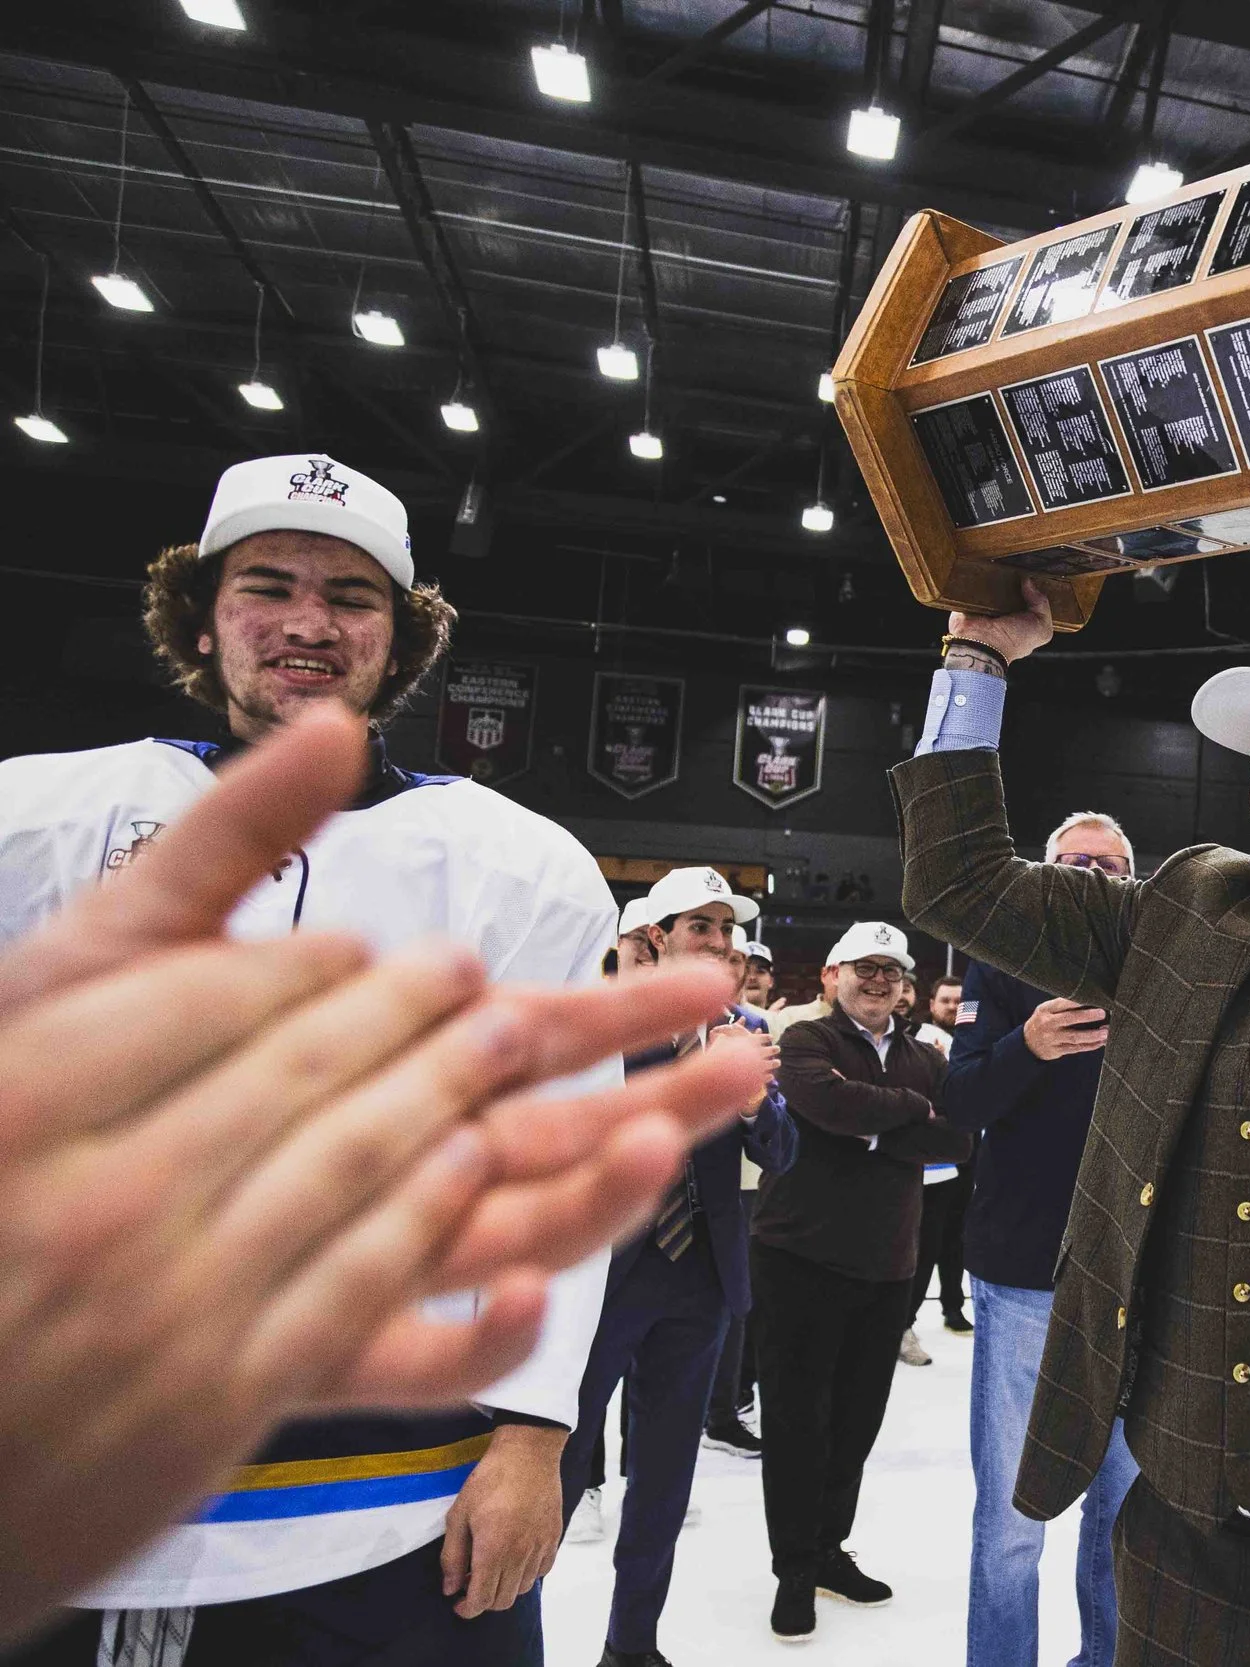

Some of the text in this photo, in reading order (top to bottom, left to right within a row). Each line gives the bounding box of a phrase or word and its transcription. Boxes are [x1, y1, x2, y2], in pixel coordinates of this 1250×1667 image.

[290, 473, 349, 492] CLARK
[300, 484, 335, 497] CUP
[748, 705, 815, 720] CLARK CUP
[747, 716, 815, 732] CHAMPIONS
